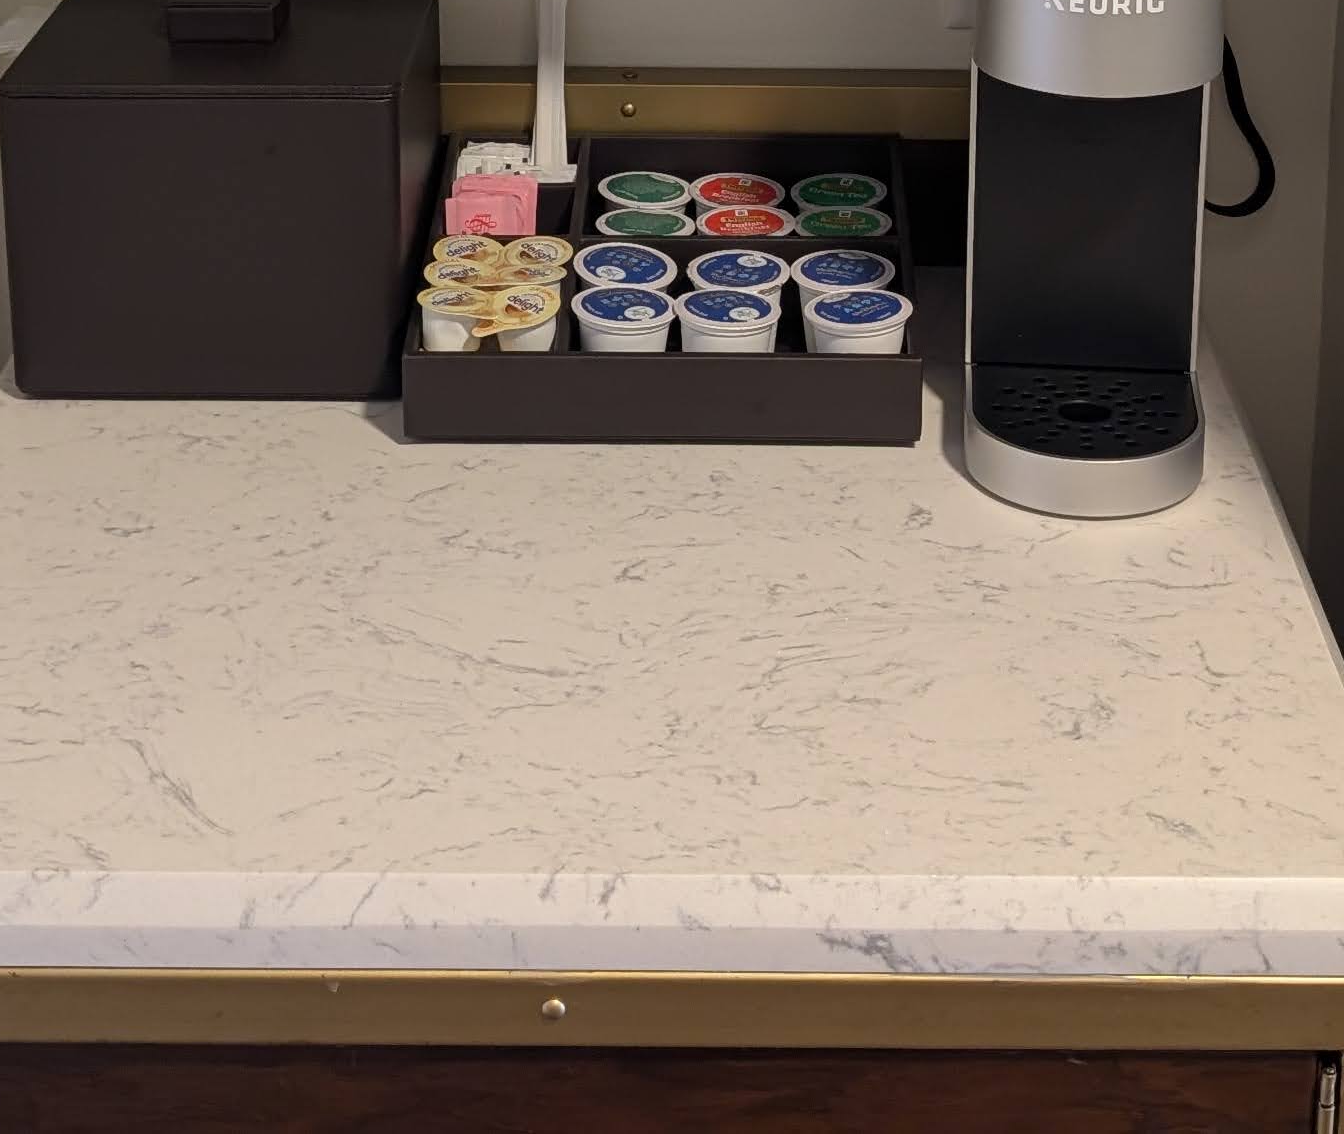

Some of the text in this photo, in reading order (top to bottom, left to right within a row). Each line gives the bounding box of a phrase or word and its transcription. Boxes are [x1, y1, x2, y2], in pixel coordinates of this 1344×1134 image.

[445, 240, 488, 257] delight
[437, 266, 480, 280] delight
[507, 294, 544, 314] delight
